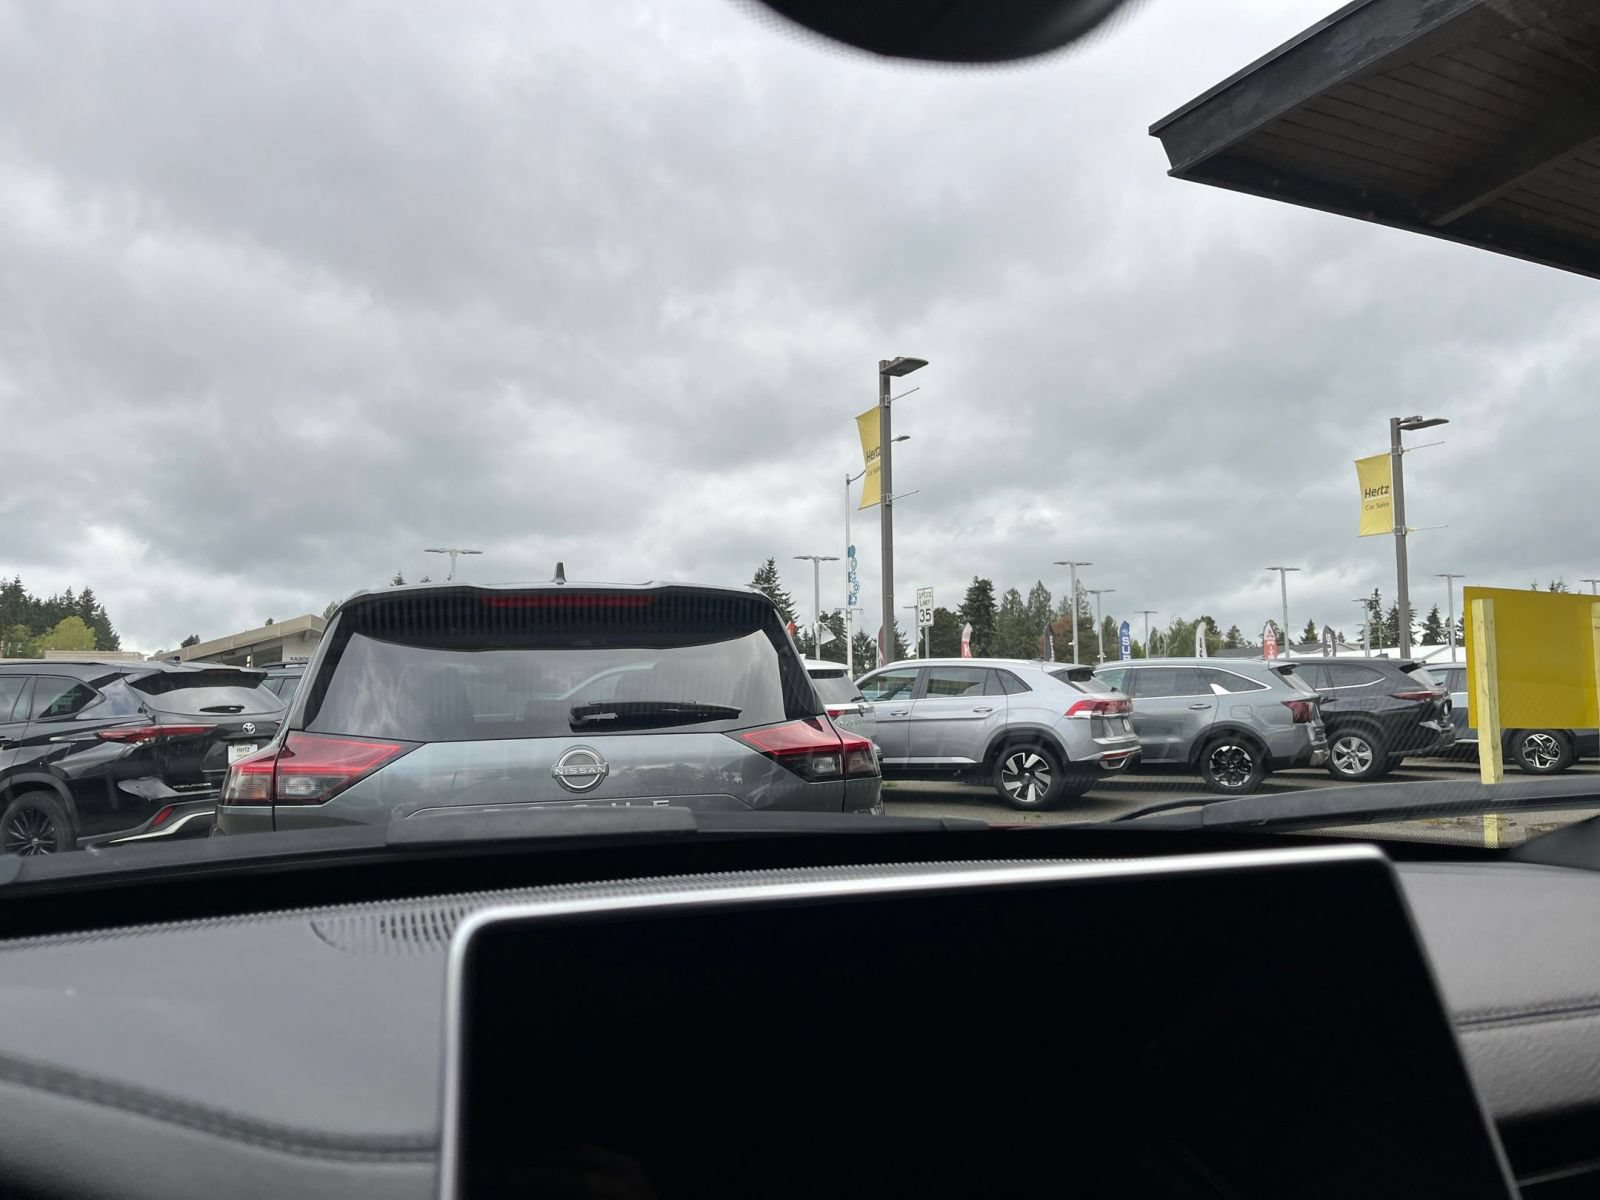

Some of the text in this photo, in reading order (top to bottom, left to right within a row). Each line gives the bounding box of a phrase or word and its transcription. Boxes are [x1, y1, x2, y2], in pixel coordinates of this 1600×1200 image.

[1364, 485, 1390, 498] Hertz
[918, 591, 932, 600] SPEED
[919, 599, 931, 607] LIMIT
[919, 608, 932, 623] 35
[554, 766, 607, 776] NISSAN
